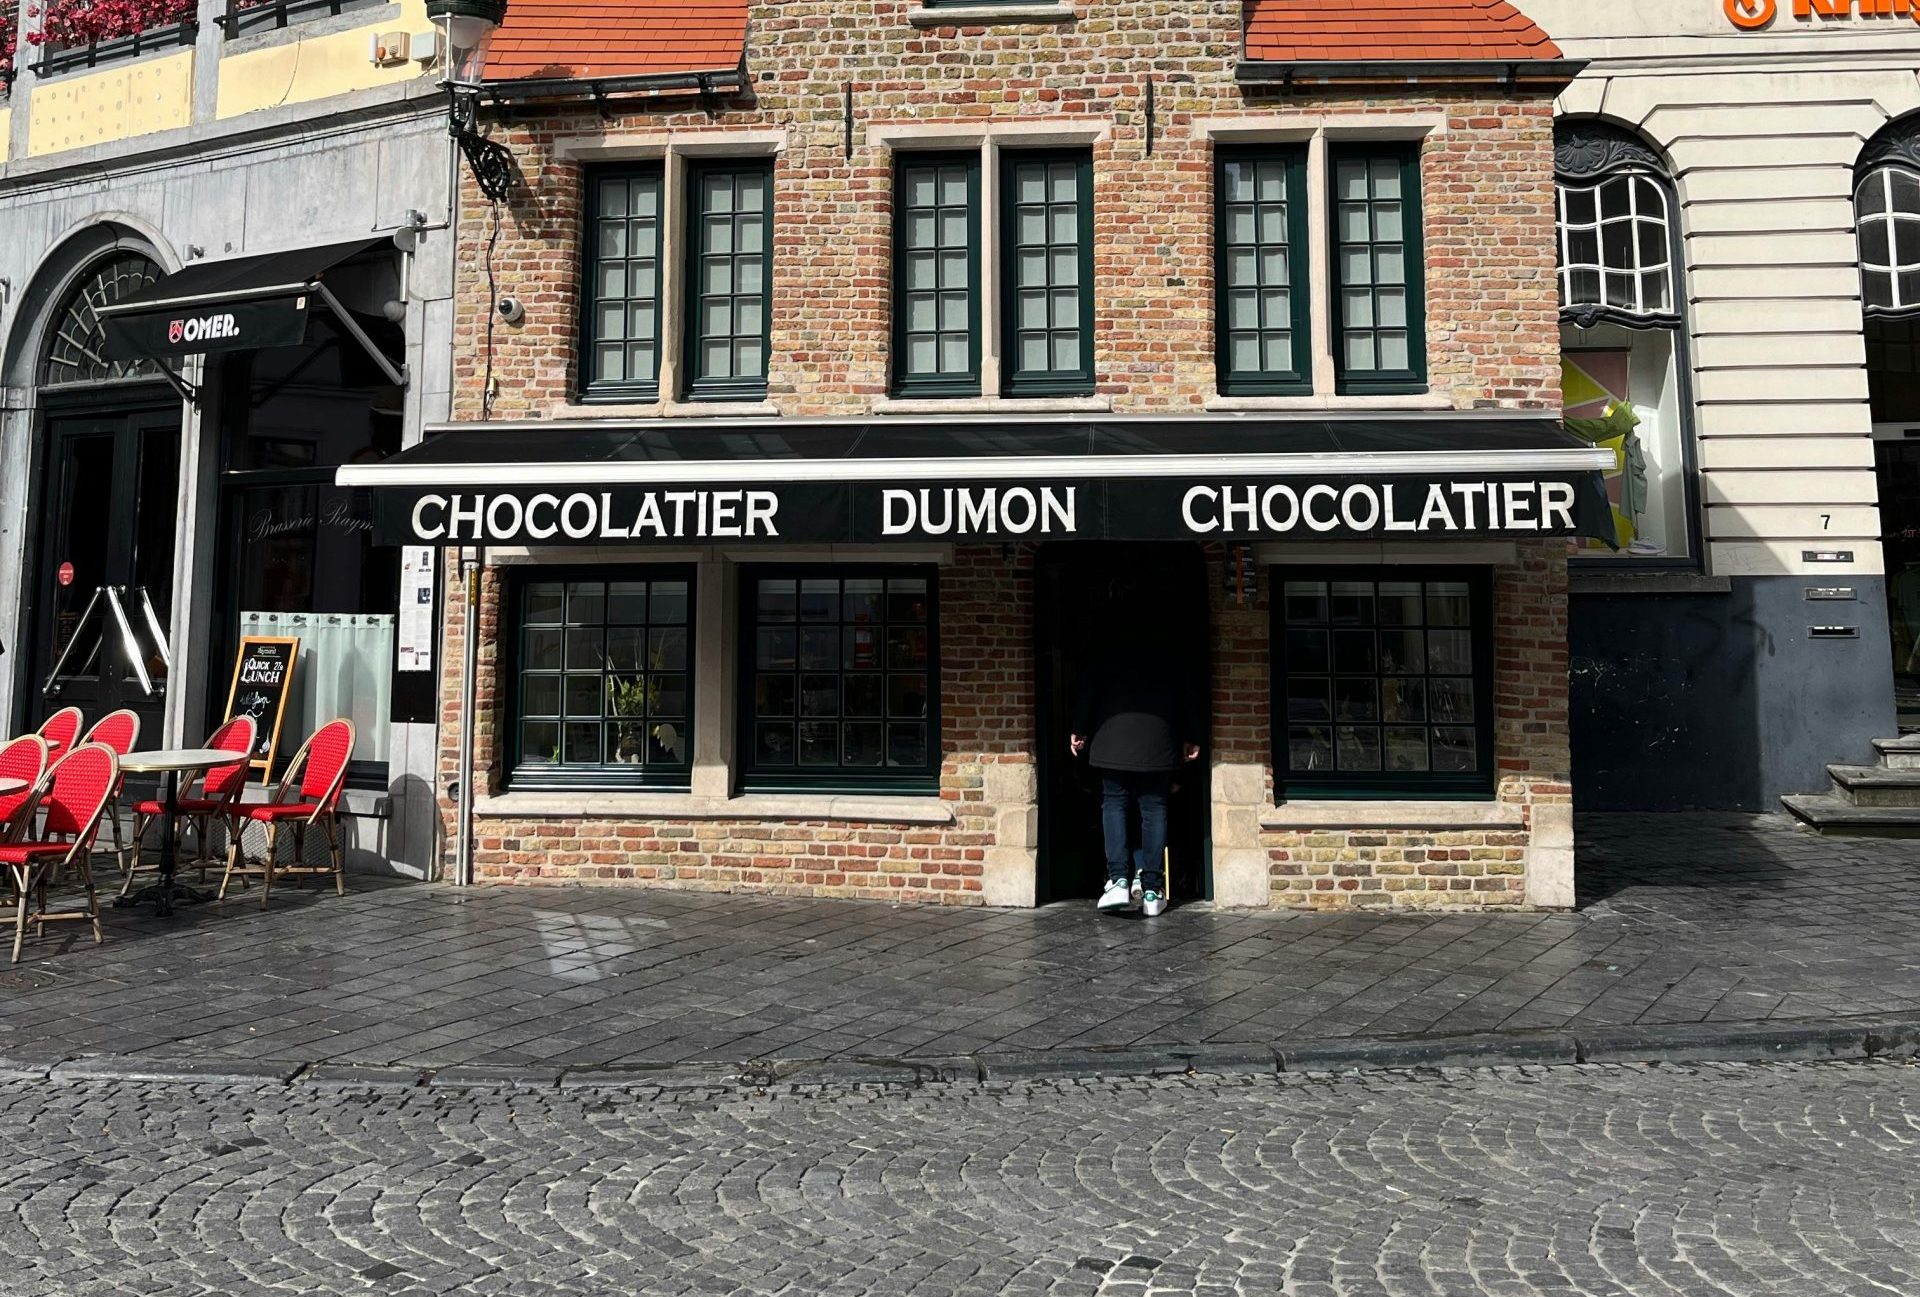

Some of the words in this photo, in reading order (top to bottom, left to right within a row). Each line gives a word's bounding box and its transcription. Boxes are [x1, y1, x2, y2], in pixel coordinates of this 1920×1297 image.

[411, 489, 780, 539] CHOCOLATIER
[881, 486, 1077, 535] DUMON
[1181, 480, 1577, 533] CHOCOLATIER
[1820, 514, 1831, 530] 7
